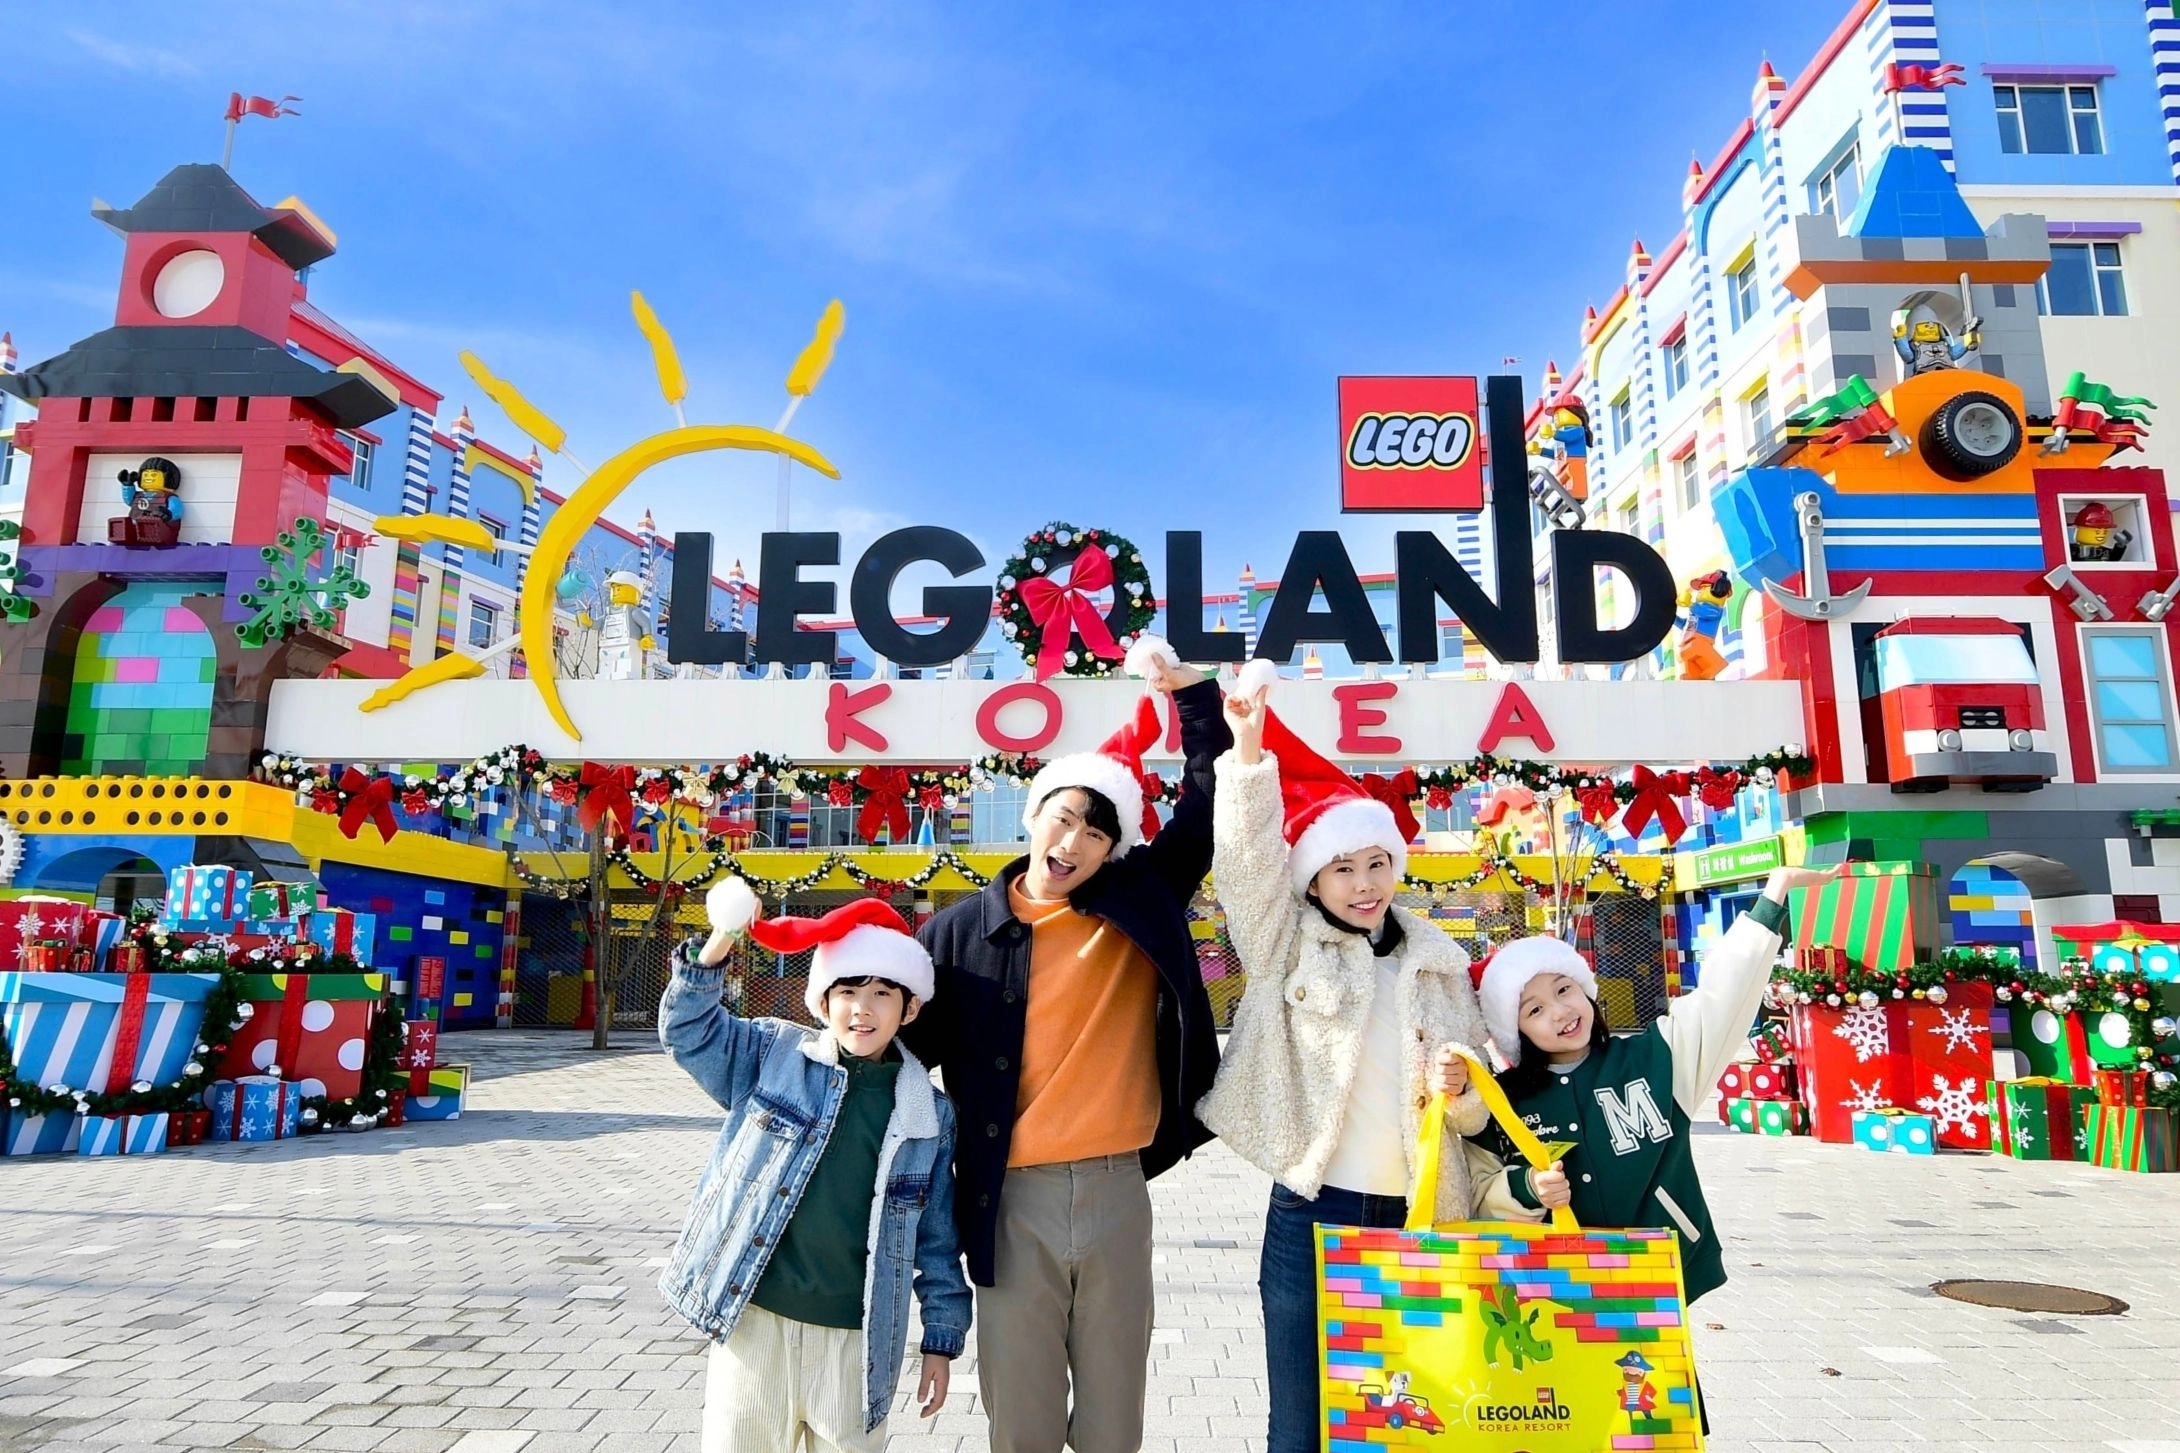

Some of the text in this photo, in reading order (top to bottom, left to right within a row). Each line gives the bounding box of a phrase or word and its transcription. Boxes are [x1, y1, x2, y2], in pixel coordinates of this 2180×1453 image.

[1347, 413, 1474, 469] LEGO
[668, 376, 1677, 664] LEGLAND
[826, 682, 1554, 753] KOEA
[1593, 1077, 1674, 1156] M
[1477, 1387, 1570, 1421] LEGOLAND
[1478, 1423, 1571, 1432] KOREA RESORT
